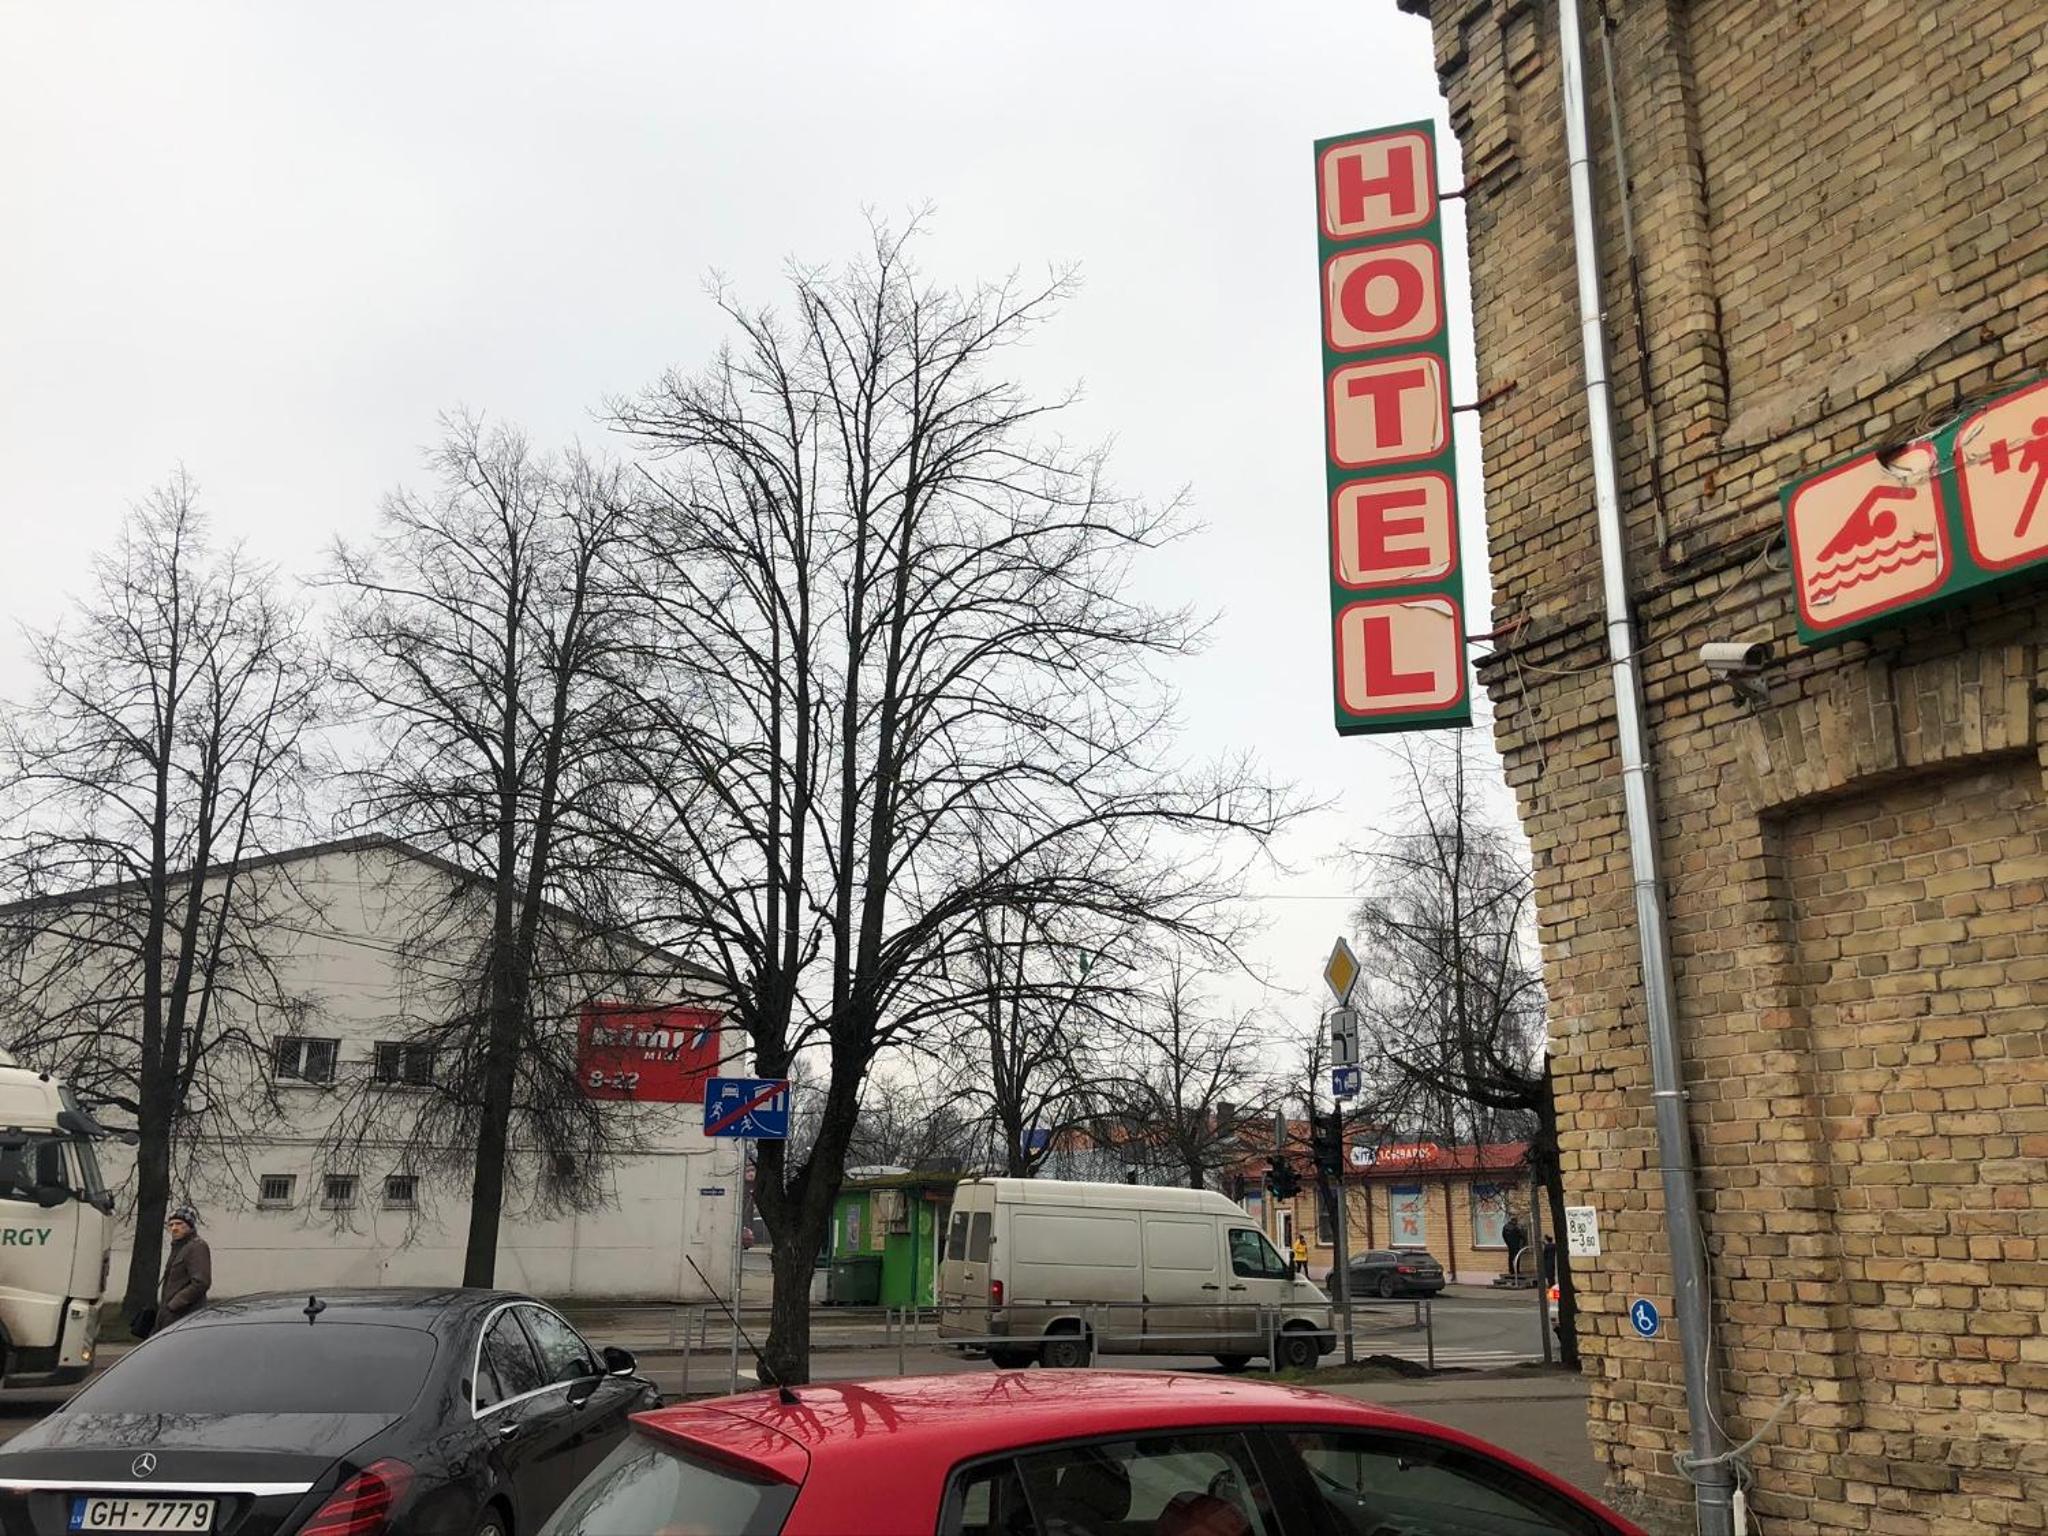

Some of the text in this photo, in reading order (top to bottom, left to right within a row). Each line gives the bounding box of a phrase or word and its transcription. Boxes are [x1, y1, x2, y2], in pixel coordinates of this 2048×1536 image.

[1337, 145, 1436, 697] HOTEL
[0, 1228, 53, 1246] RGY
[90, 1501, 209, 1528] GH-7779
